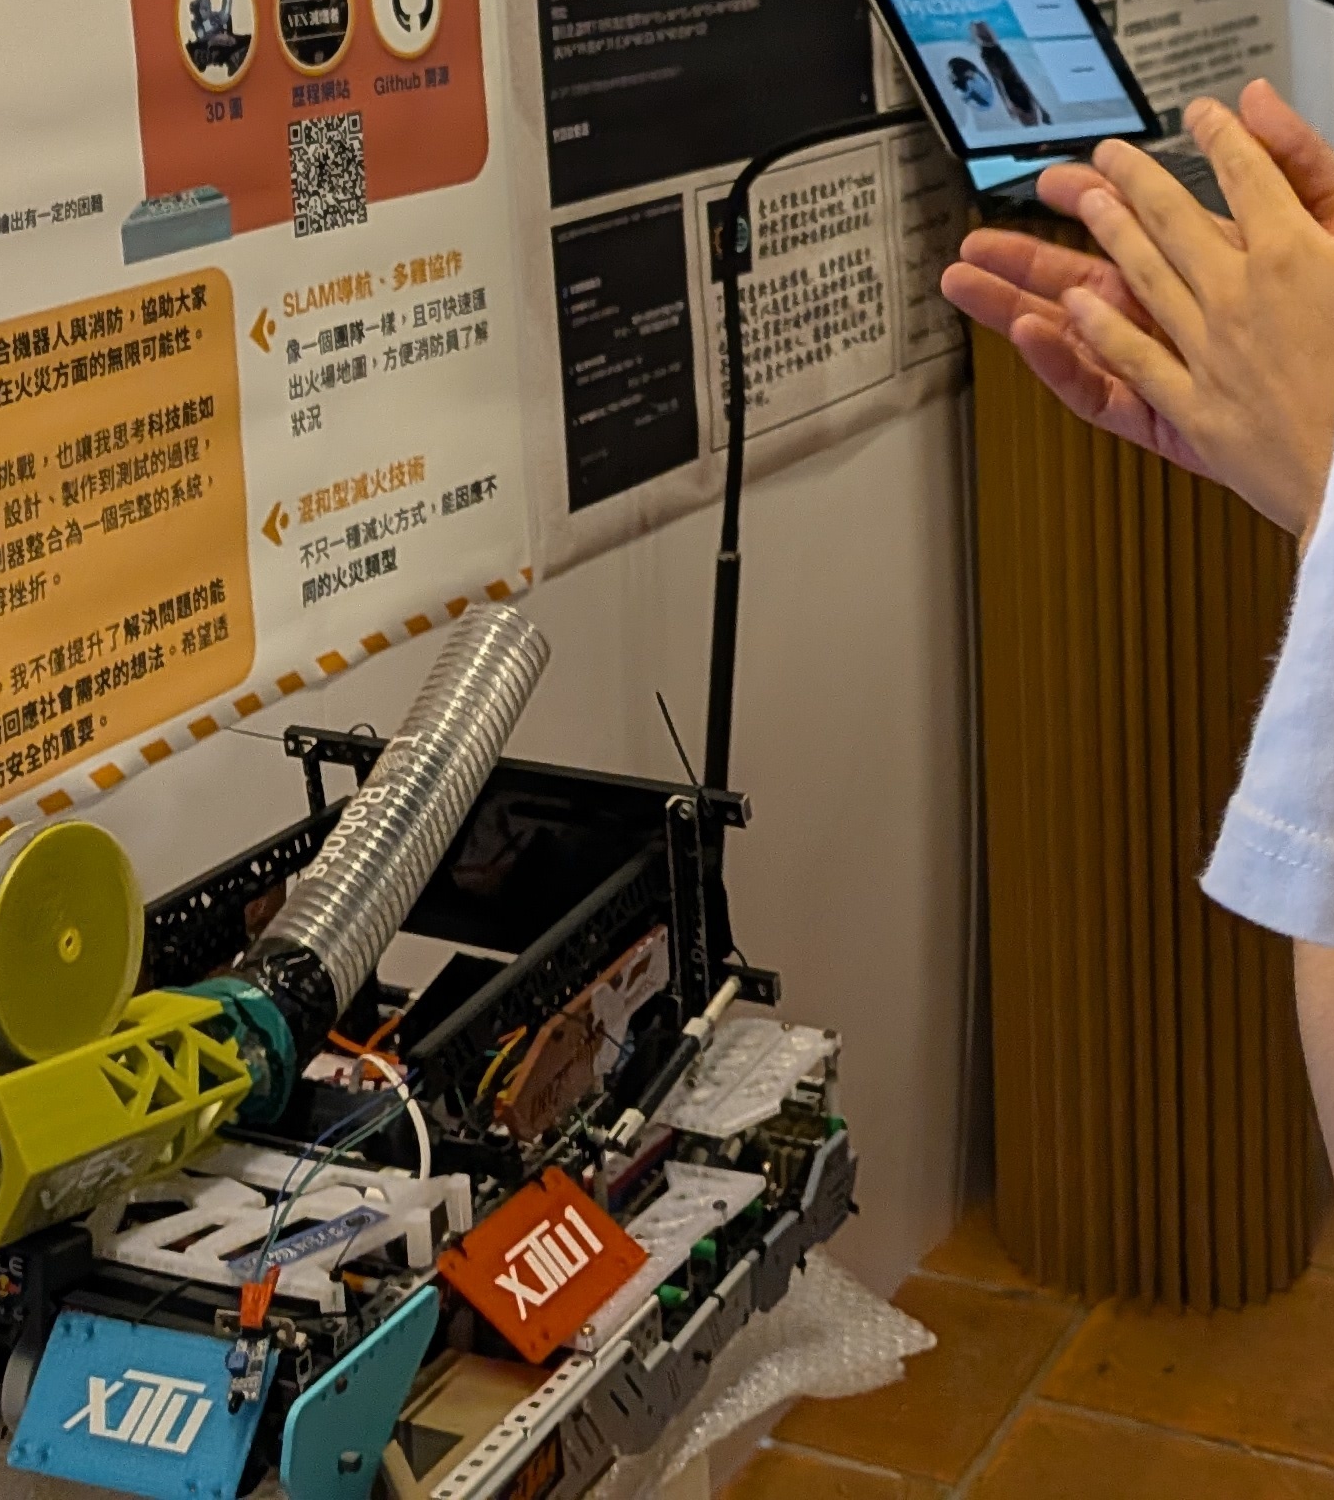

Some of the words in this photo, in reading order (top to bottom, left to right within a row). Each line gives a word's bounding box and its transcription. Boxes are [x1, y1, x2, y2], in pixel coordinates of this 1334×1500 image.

[374, 72, 422, 97] Github
[205, 102, 226, 124] 3D
[291, 405, 322, 438] 狀況
